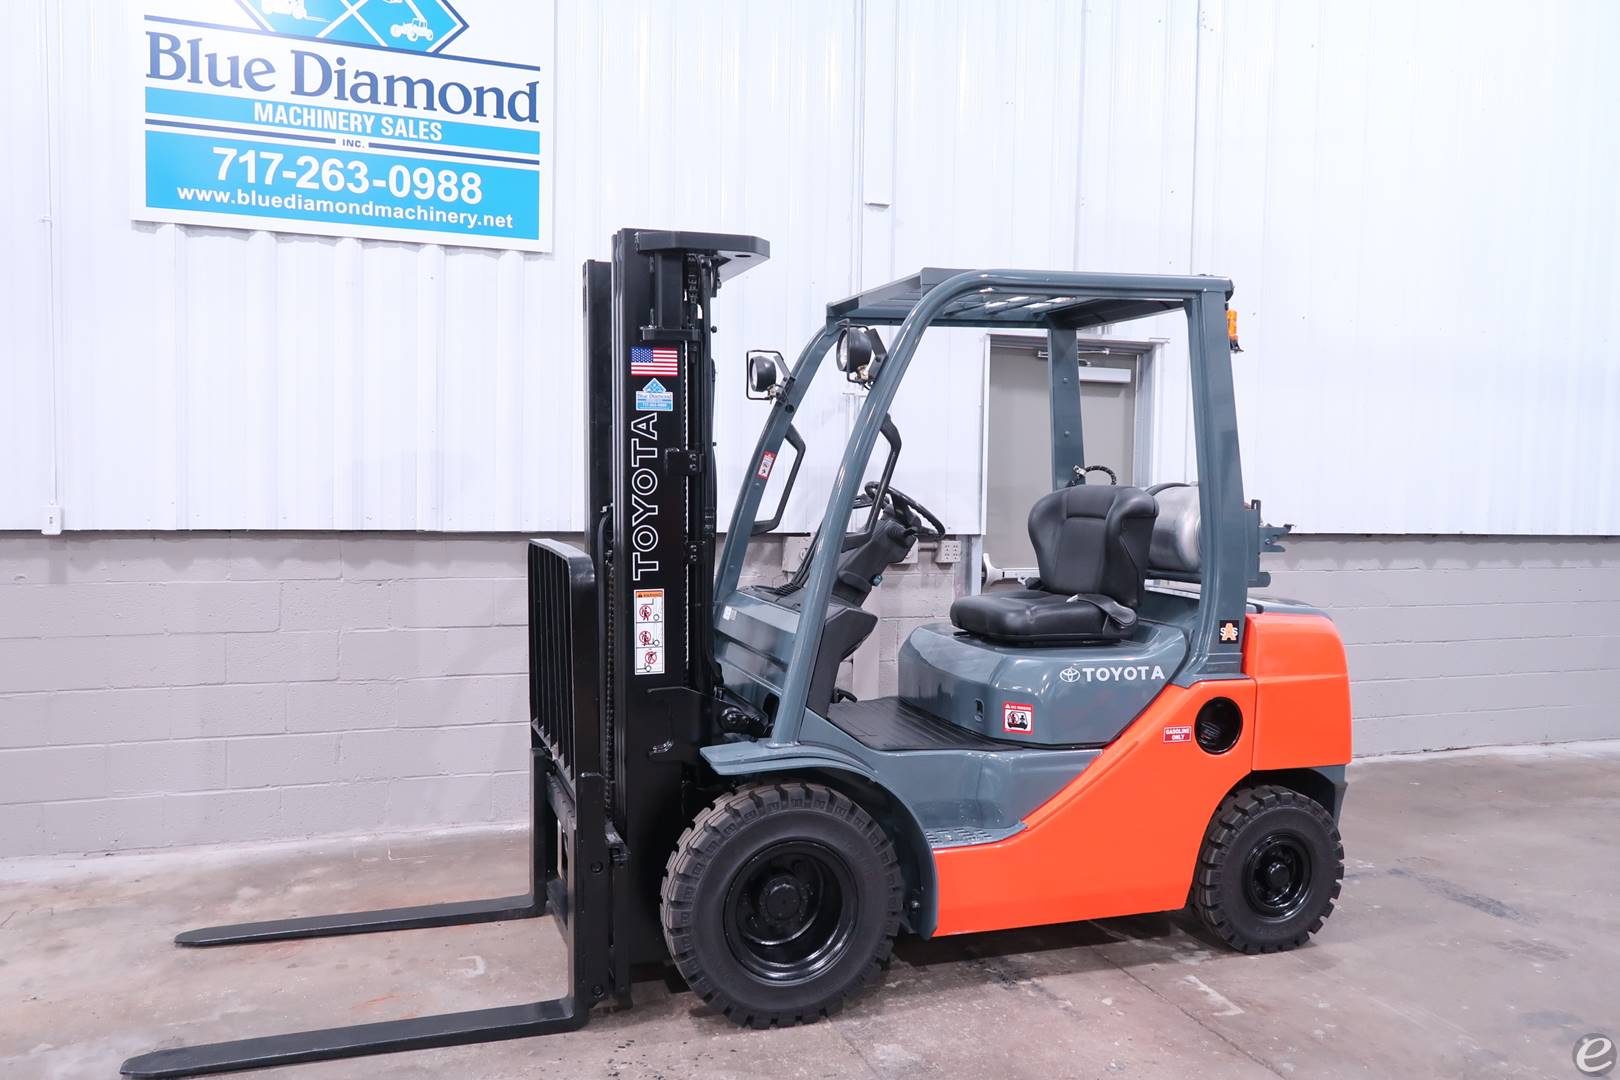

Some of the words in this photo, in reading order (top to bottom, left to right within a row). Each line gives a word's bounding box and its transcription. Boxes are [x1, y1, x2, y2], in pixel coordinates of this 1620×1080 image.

[145, 31, 276, 92] Blue
[290, 49, 540, 123] Diamond
[254, 102, 375, 134] MACHINERY
[381, 118, 443, 141] SALES
[342, 138, 365, 149] INC.
[212, 146, 482, 204] 717-263-0988
[177, 186, 513, 229] www.bluediamondmachinery.net
[631, 412, 659, 581] TOYOTA
[1082, 665, 1165, 682] TOYOTA
